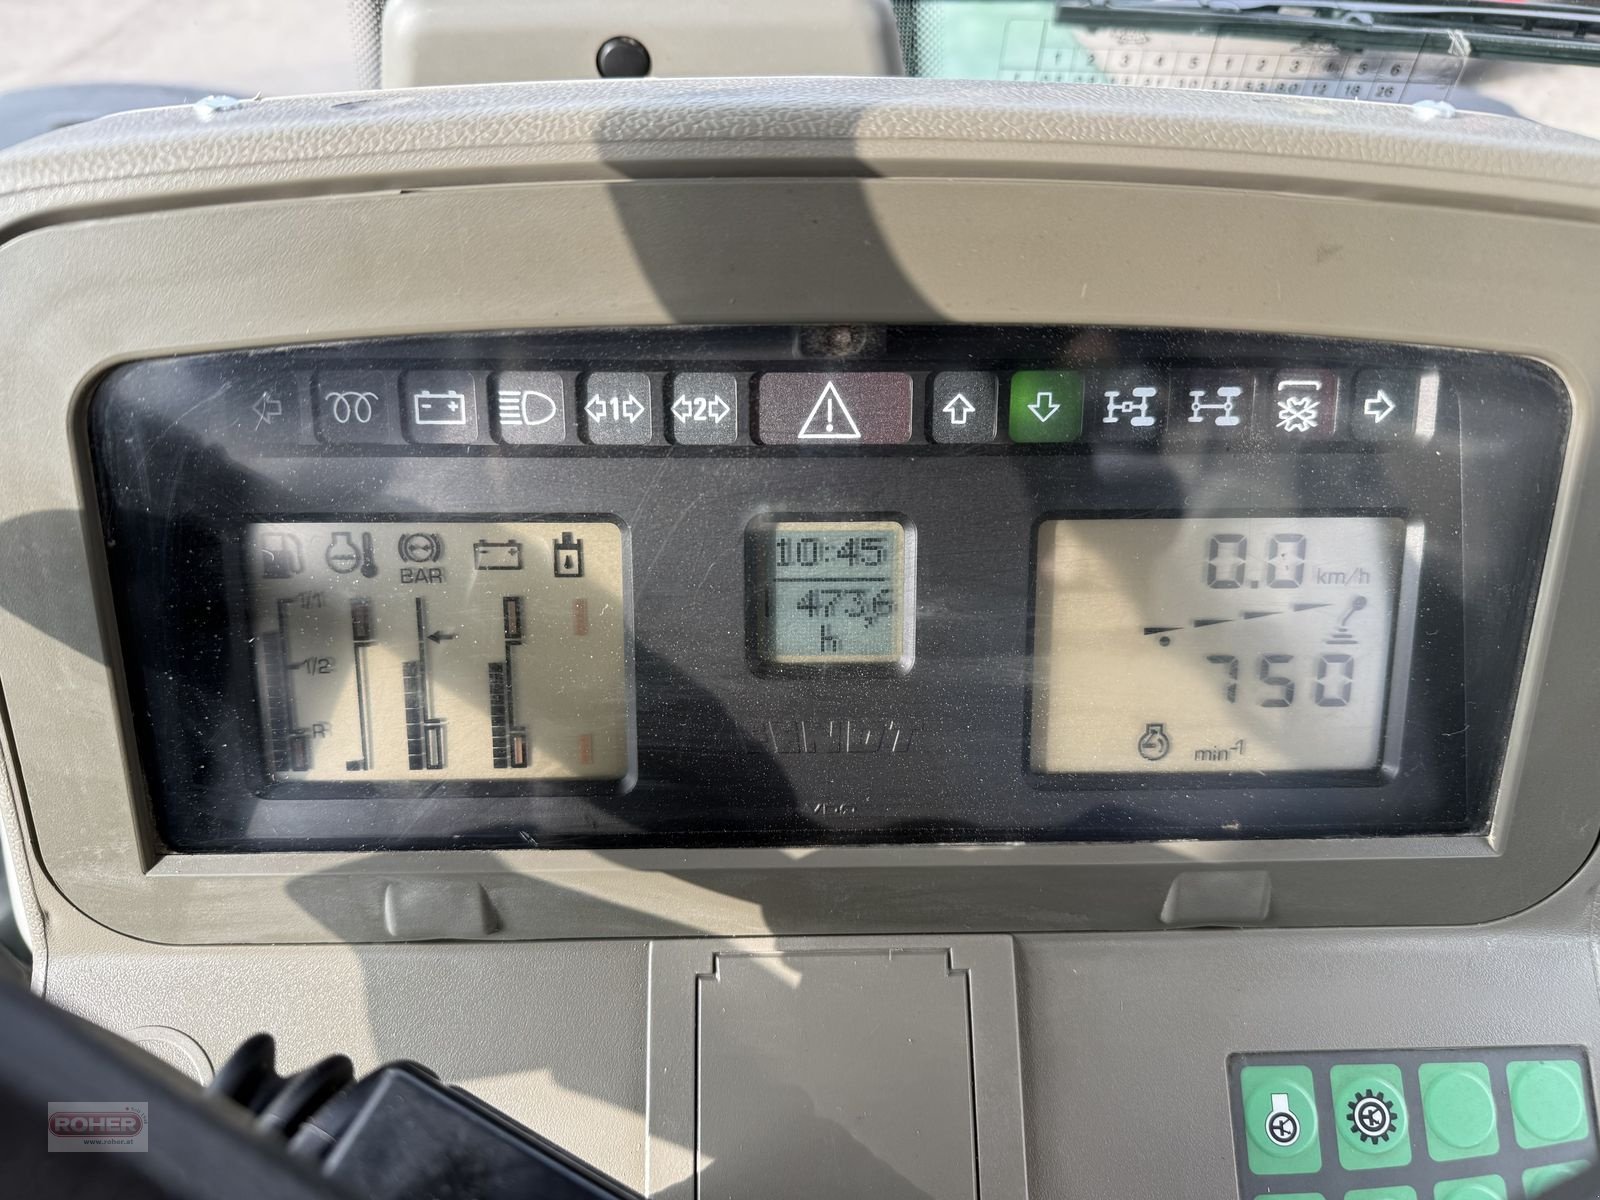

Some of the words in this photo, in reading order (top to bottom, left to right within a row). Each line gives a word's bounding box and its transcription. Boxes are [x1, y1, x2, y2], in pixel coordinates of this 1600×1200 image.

[609, 397, 620, 421] 1
[693, 397, 707, 421] 2
[776, 537, 882, 567] 10:45
[1206, 533, 1307, 589] 0.0
[1315, 567, 1371, 587] km/h
[400, 567, 444, 585] BAR
[820, 624, 838, 652] h
[302, 657, 332, 674] 1/2
[1206, 653, 1354, 708] 750
[311, 723, 326, 738] R
